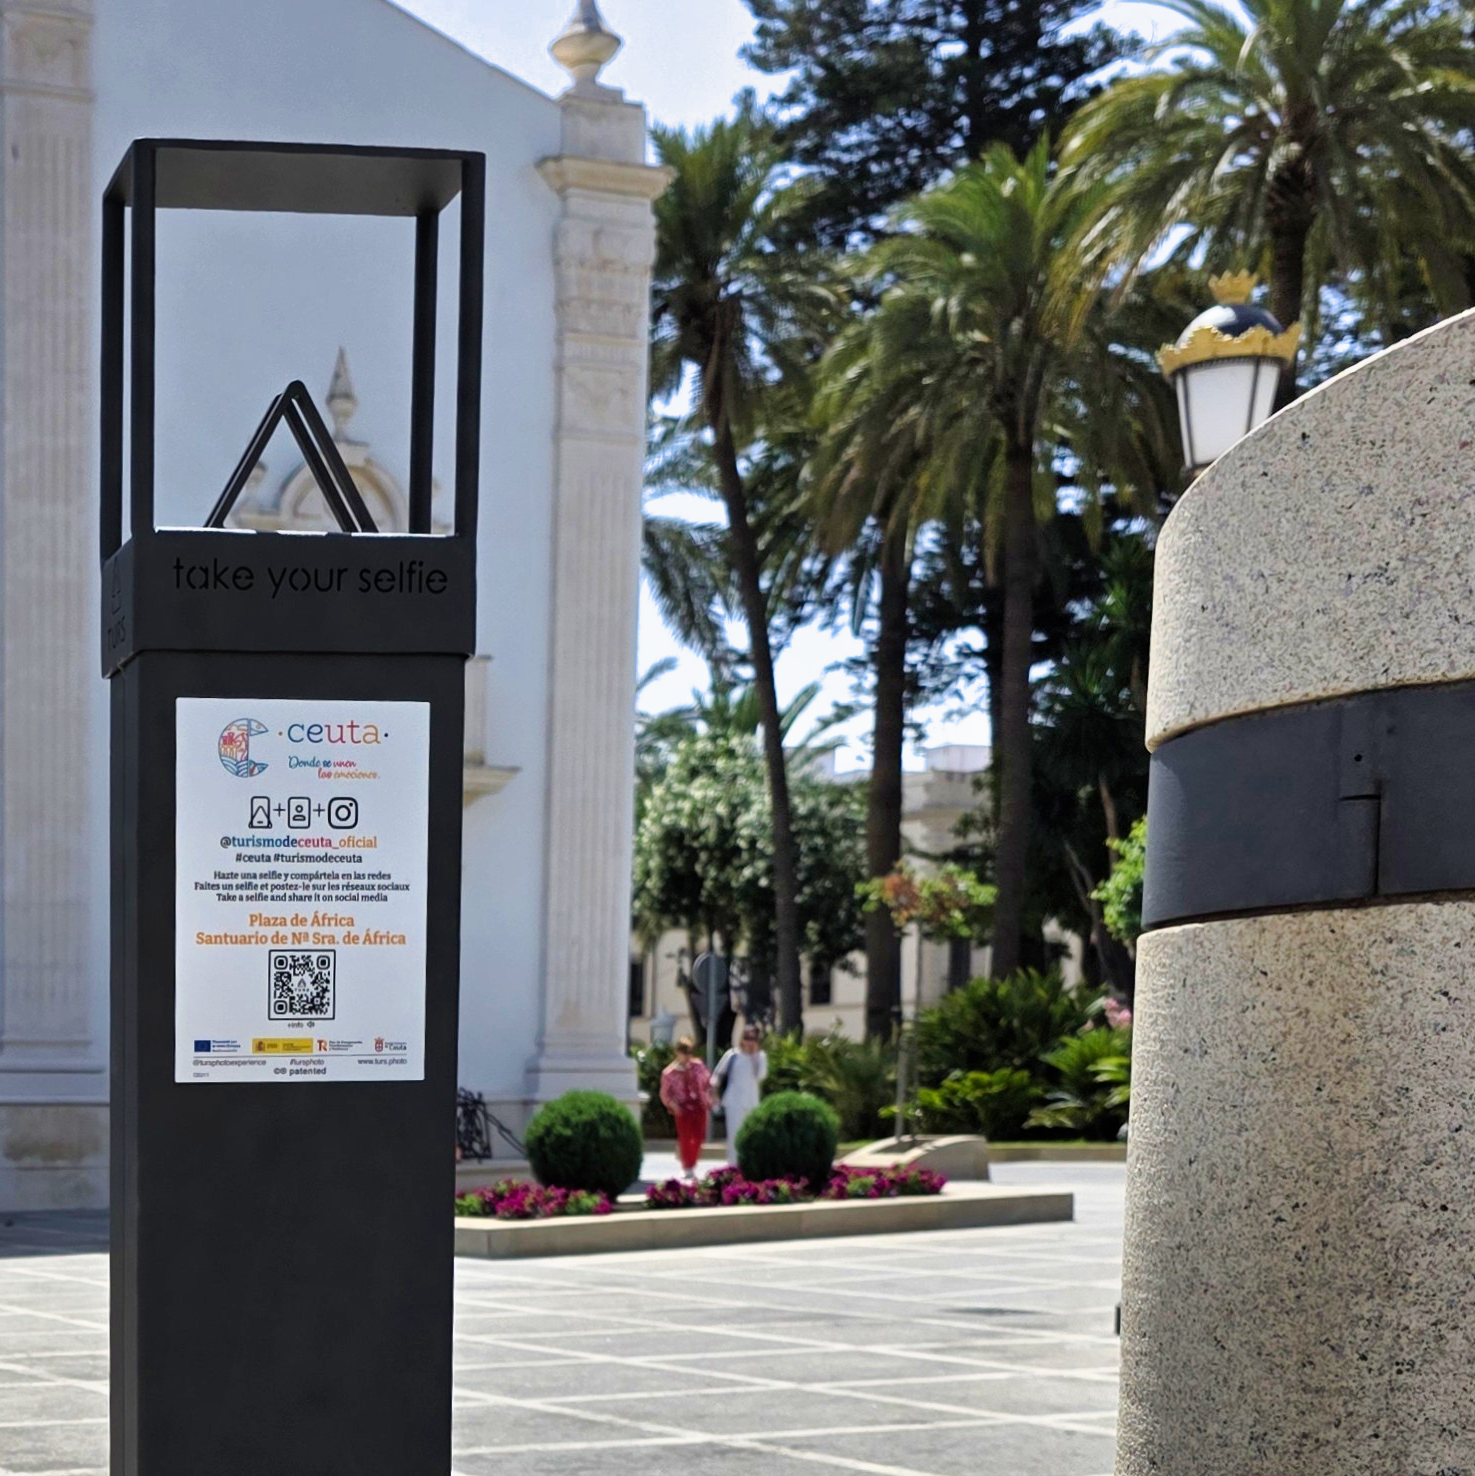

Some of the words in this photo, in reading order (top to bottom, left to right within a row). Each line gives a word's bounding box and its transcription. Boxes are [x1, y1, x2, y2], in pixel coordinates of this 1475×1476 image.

[173, 557, 254, 592] take
[267, 566, 348, 599] your
[358, 560, 448, 594] selfie
[288, 755, 321, 769] Donde
[220, 835, 377, 850] @turismodeceuta_oficial
[235, 852, 271, 863] #ceuta
[273, 852, 362, 863] #turismodeceuta
[214, 870, 239, 880] Hazte
[259, 870, 282, 880] selfie
[283, 873, 289, 882] y
[290, 870, 340, 882] compártela
[354, 871, 366, 880] las
[367, 871, 391, 880] redes
[194, 881, 220, 891] Faites
[222, 883, 233, 891] un
[235, 881, 259, 891] selfie
[260, 882, 268, 891] et
[270, 881, 310, 893] postez-le
[312, 883, 326, 891] sur
[327, 882, 340, 891] les
[342, 882, 375, 891] réseaux
[377, 882, 410, 891] sociaux
[216, 893, 236, 902] Take
[245, 893, 268, 902] selfie
[270, 893, 286, 902] and
[288, 893, 312, 902] share
[314, 893, 320, 902] it
[335, 893, 359, 902] social
[361, 893, 388, 902] media
[249, 914, 287, 927] Plaza
[290, 914, 308, 927] de
[311, 911, 355, 927] África
[196, 932, 268, 945] Santuario
[271, 932, 288, 945] de
[312, 932, 340, 945] Sra.
[342, 932, 360, 945] de
[362, 929, 406, 945] África
[289, 1067, 327, 1076] patented
